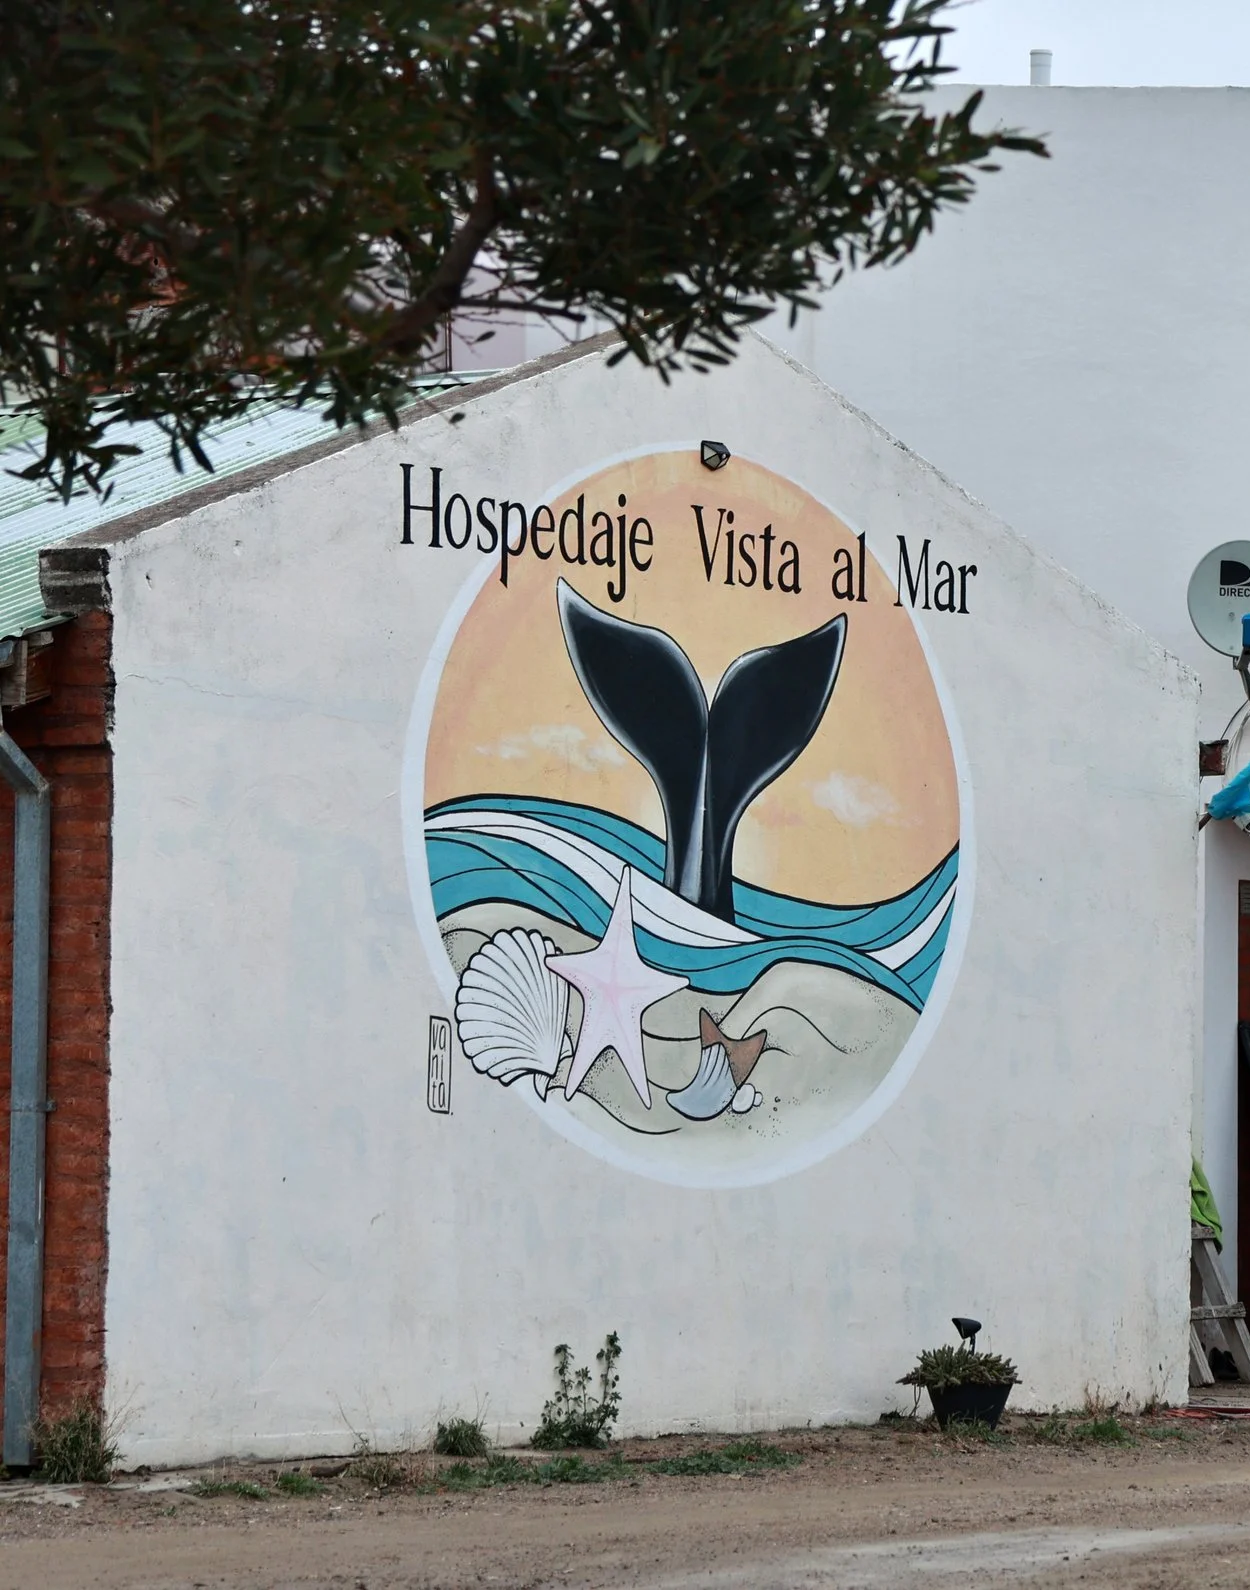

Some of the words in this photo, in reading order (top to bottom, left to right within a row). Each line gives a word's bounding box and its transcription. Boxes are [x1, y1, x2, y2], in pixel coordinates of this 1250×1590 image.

[399, 463, 654, 602] Hospedaje
[690, 504, 802, 594] Vista
[831, 531, 868, 602] al
[893, 534, 978, 615] Mar
